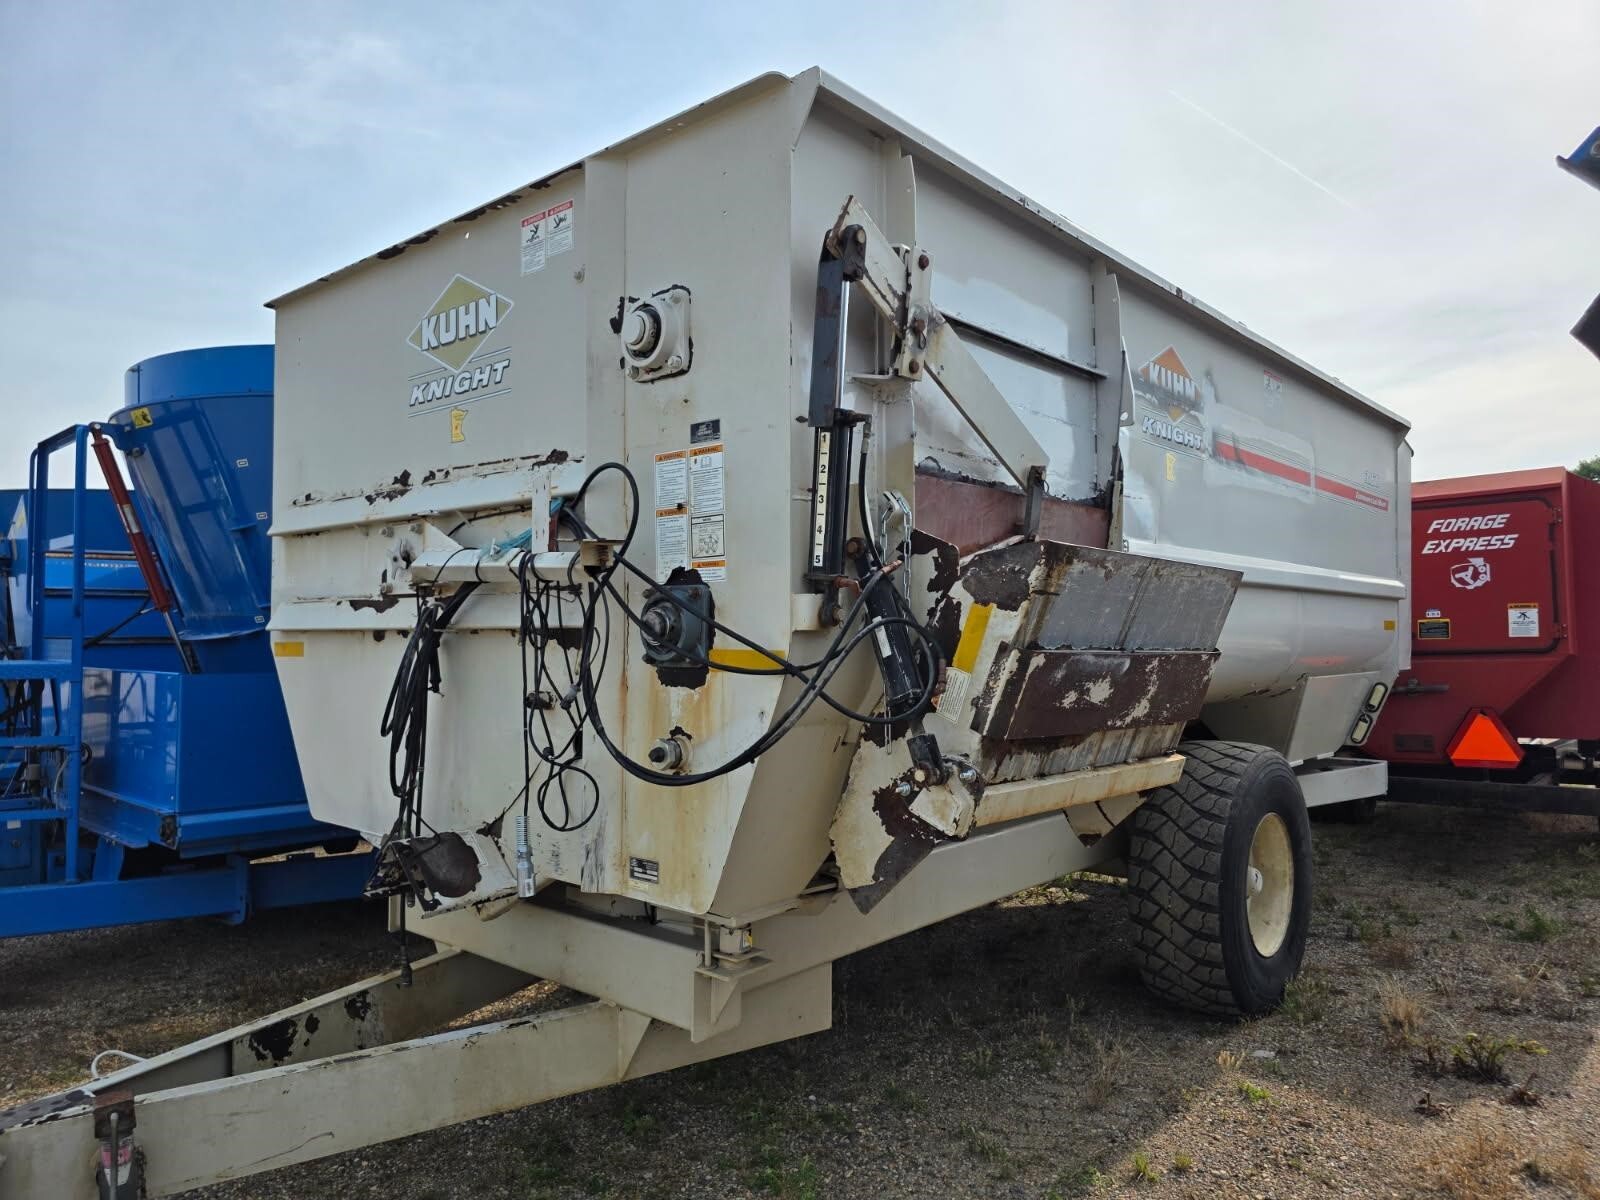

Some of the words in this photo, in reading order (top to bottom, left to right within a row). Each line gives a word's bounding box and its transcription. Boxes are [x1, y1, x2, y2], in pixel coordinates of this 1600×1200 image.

[420, 293, 497, 351] KUHN
[409, 359, 511, 406] KNIGHT
[1149, 361, 1197, 402] KUHN
[822, 433, 827, 442] 1
[1142, 415, 1202, 450] KNIGHT
[820, 464, 827, 473] 2
[818, 494, 825, 503] 3
[816, 525, 823, 535] 4
[1427, 514, 1511, 534] FORAGE
[1421, 534, 1519, 554] EXPRESS
[815, 554, 821, 563] 5
